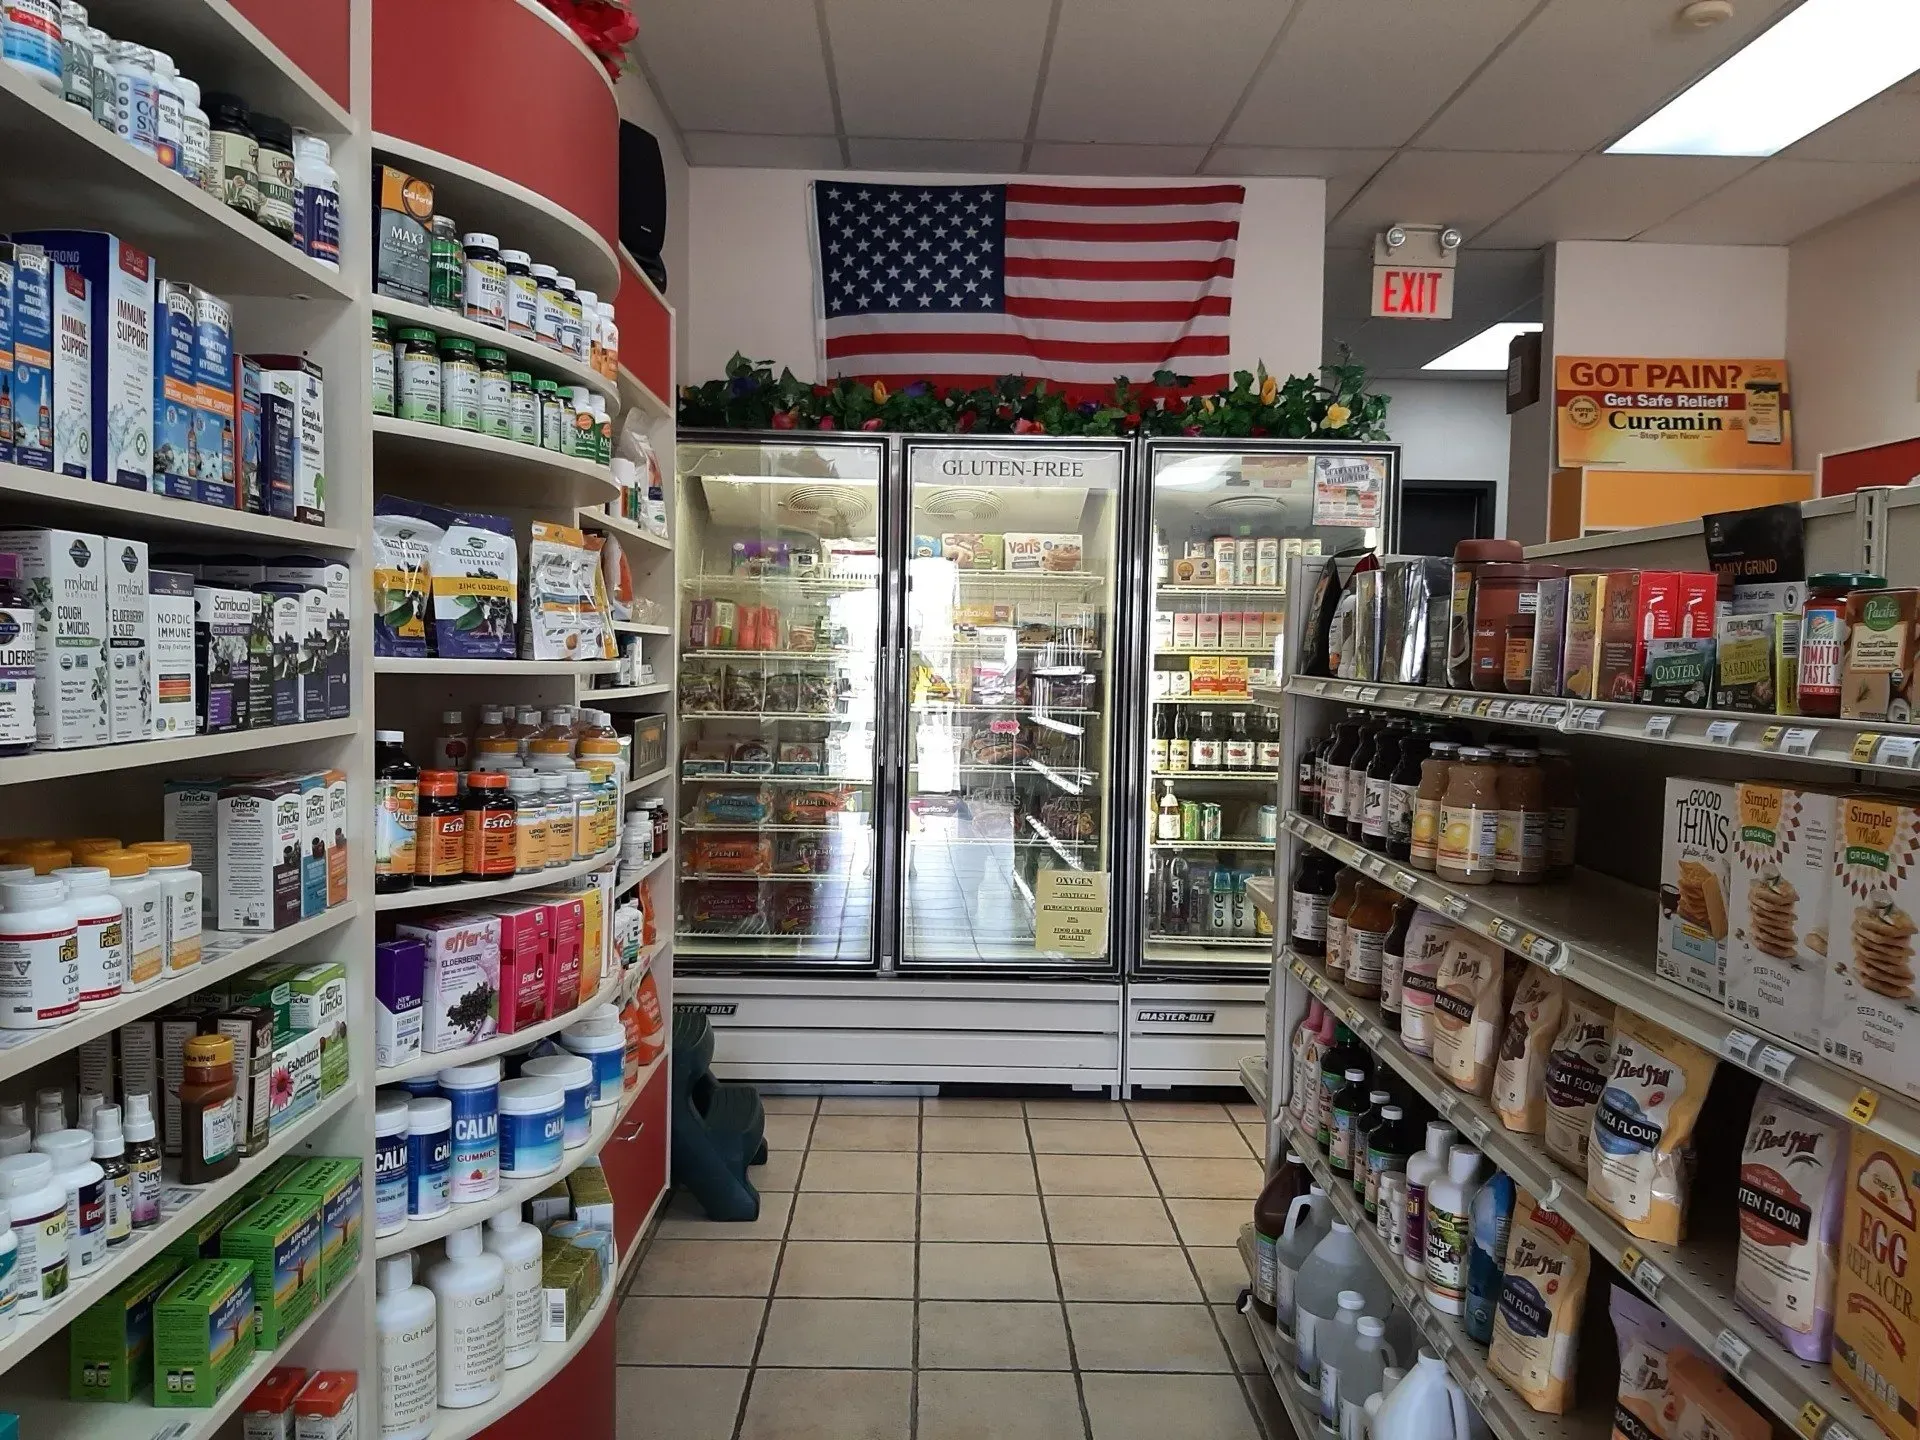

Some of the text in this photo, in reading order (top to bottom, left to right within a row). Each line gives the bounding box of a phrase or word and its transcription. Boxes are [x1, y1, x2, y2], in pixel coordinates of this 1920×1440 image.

[391, 226, 424, 245] MAX3
[1384, 271, 1442, 313] EXIT
[117, 298, 148, 330] IMMUNE
[199, 309, 228, 329] SILVER
[61, 313, 87, 341] IMMUNE
[116, 320, 149, 352] SUPPORT
[61, 334, 89, 361] SUPPORT
[1570, 363, 1743, 388] GOT PAIN?
[1604, 393, 1728, 408] Get Safe Relief!
[1608, 410, 1723, 431] Curamin
[1639, 431, 1658, 440] Stop
[1660, 431, 1679, 440] Pain
[942, 459, 1084, 478] GLUTEN-FREE
[1745, 559, 1778, 576] GRIND
[64, 573, 98, 597] mykind
[117, 581, 144, 600] mykind
[57, 606, 82, 620] COUGH
[112, 609, 144, 624] ELDERBERRY
[158, 613, 191, 625] NORDIC
[1866, 600, 1898, 620] Pacific
[58, 621, 90, 636] & MUCUS
[113, 624, 135, 637] & SLEEP
[158, 627, 191, 639] IMMUNE
[1802, 646, 1840, 665] TOMATO
[1655, 664, 1701, 680] OYSTERS
[1723, 659, 1767, 677] SARDINES
[1803, 665, 1832, 685] PASTE
[1855, 748, 1868, 756] Free
[180, 793, 210, 802] Umcka
[231, 799, 260, 808] Umcka
[1689, 789, 1722, 811] GOOD
[1745, 790, 1778, 809] Simple
[277, 812, 300, 826] Umcka
[306, 805, 325, 819] Umcka
[1749, 808, 1772, 825] Mills
[1851, 806, 1892, 828] Simple
[1676, 798, 1730, 854] THINS
[1745, 829, 1773, 843] ORGANIC
[1856, 827, 1884, 846] Mills
[1850, 851, 1885, 868] ORGANIC
[1056, 876, 1093, 885] OXYGEN
[441, 953, 482, 968] ELDERBERRY
[1753, 966, 1791, 987] SEED FLOUR
[320, 993, 342, 1016] Umcka
[1435, 994, 1456, 1010] BARLEY
[1857, 1006, 1904, 1031] SEED FLOUR
[198, 1054, 216, 1062] Well
[288, 1049, 320, 1073] Esberitox
[1615, 1060, 1670, 1087] Red Mill
[1573, 1077, 1601, 1096] FLOUR
[1853, 1107, 1867, 1118] Free
[456, 1114, 498, 1140] CALM
[1617, 1119, 1658, 1143] FLOUR
[1754, 1128, 1791, 1153] Red
[375, 1146, 407, 1172] CALM
[457, 1149, 496, 1162] GUMMIES
[377, 1195, 396, 1203] DRINK
[1764, 1200, 1801, 1230] FLOUR
[46, 1223, 60, 1236] Oil
[290, 1225, 311, 1246] Allergy
[1859, 1206, 1908, 1278] EGG
[523, 1260, 536, 1271] Gut
[474, 1293, 490, 1307] Gut
[1503, 1288, 1540, 1321] OAT FLOUR
[402, 1328, 418, 1343] Gut
